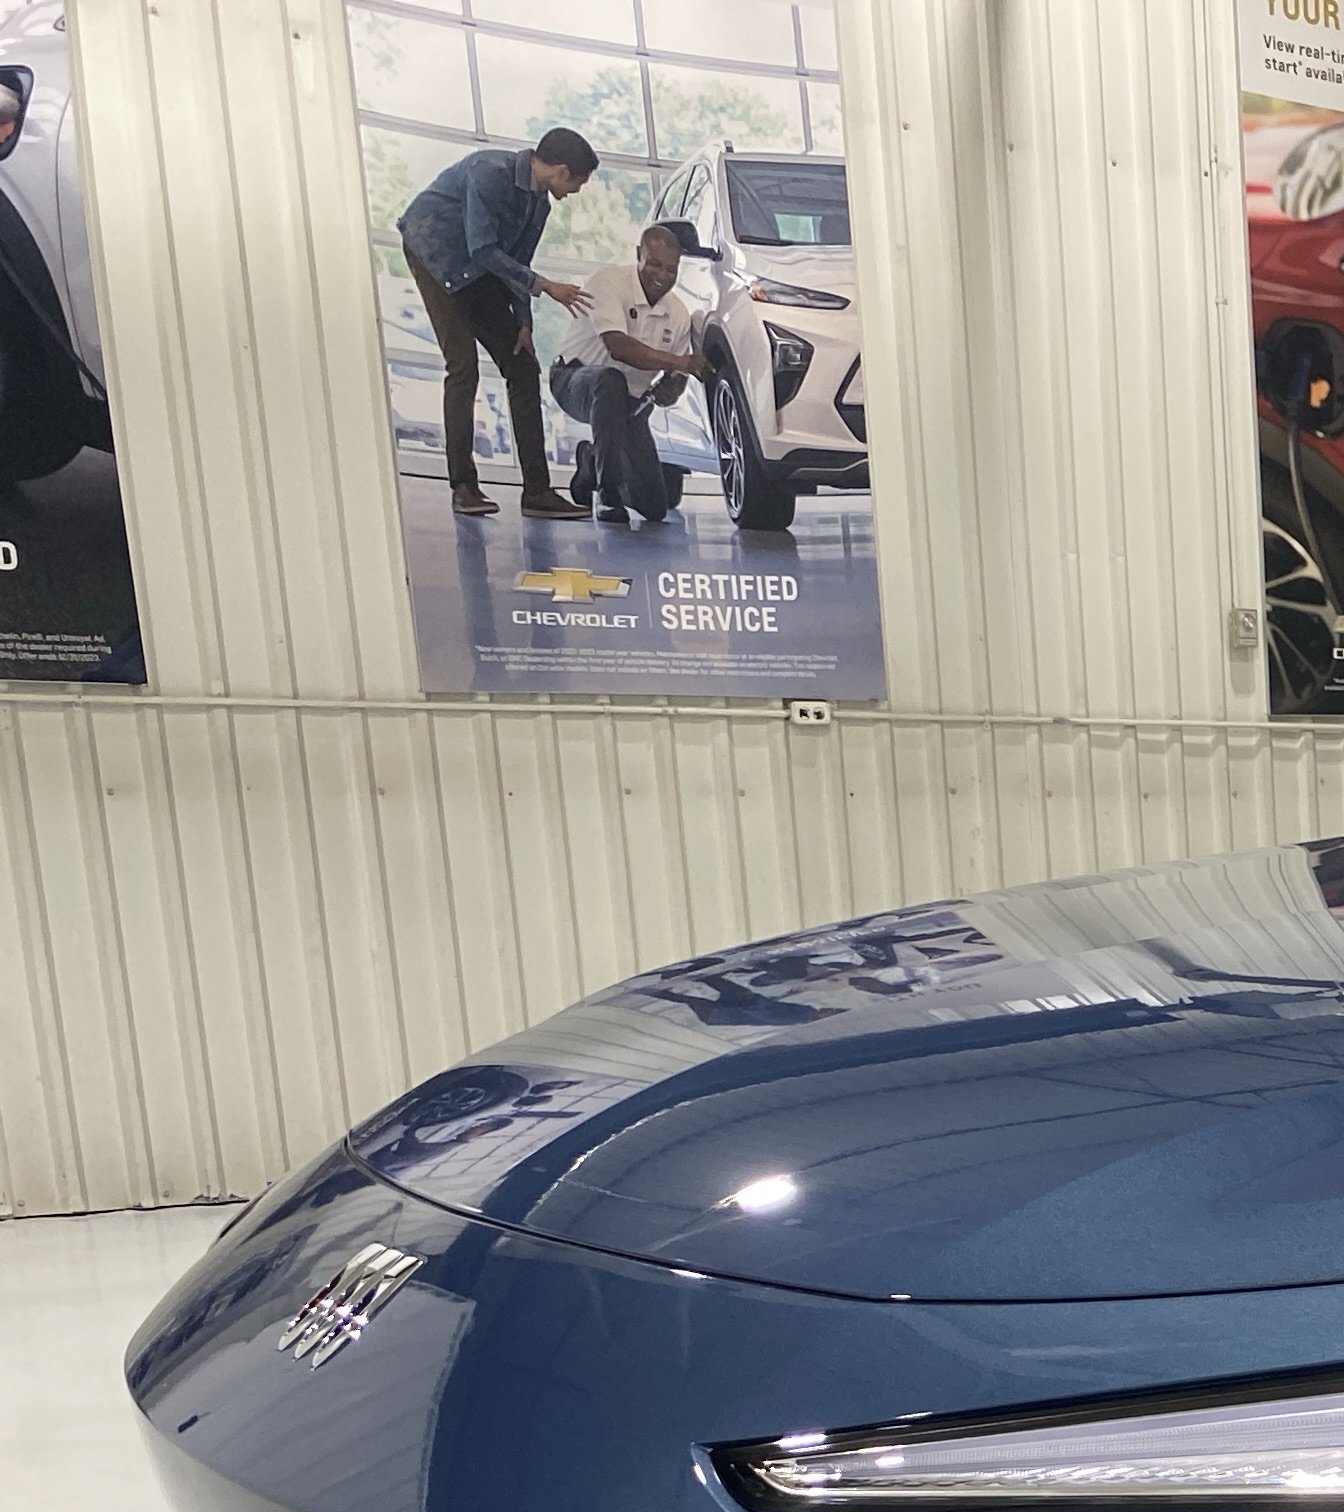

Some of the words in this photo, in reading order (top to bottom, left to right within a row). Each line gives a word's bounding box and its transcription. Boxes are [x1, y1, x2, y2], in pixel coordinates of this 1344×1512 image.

[1263, 34, 1295, 54] View
[658, 571, 799, 602] CERTIFIED
[512, 610, 639, 629] CHEVROLET
[661, 604, 779, 633] SERVICE
